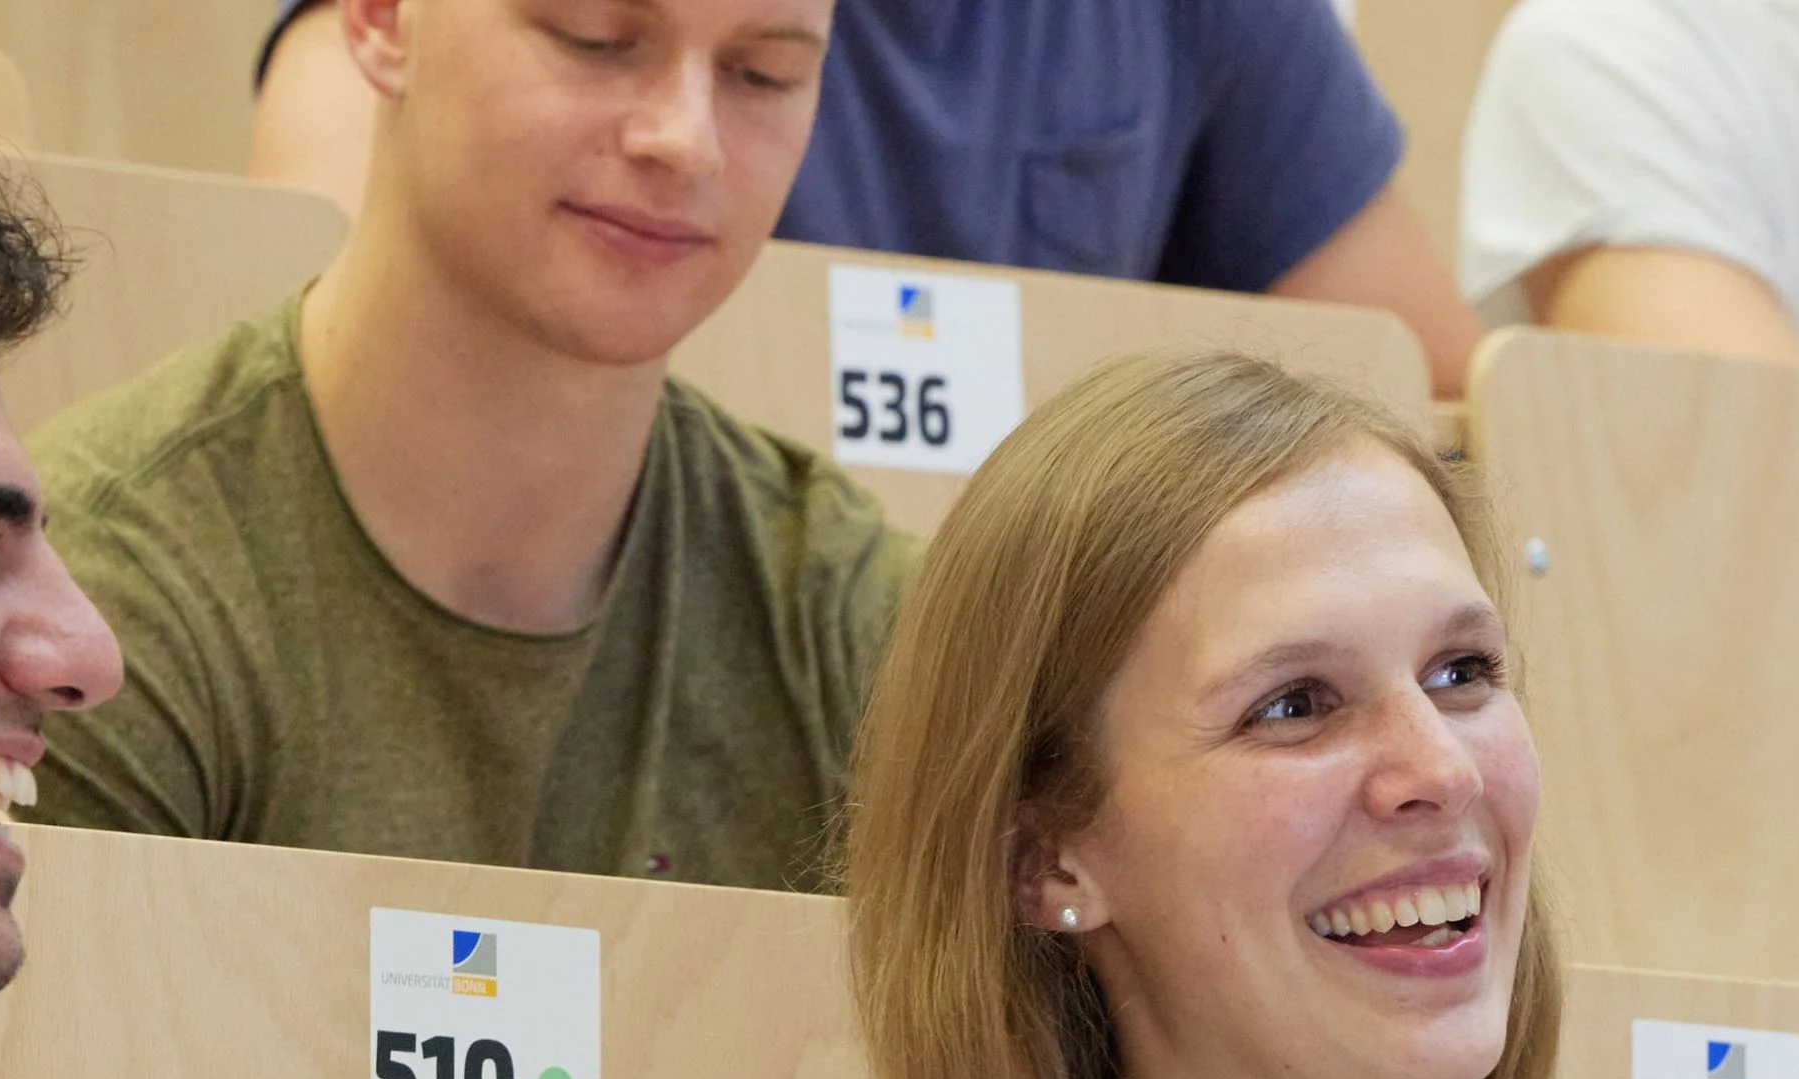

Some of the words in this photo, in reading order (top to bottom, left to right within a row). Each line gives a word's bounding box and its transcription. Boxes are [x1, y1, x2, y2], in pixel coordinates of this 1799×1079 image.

[839, 370, 950, 447] 536
[381, 971, 451, 990] UNIVERSITÄT
[453, 978, 487, 995] BONN
